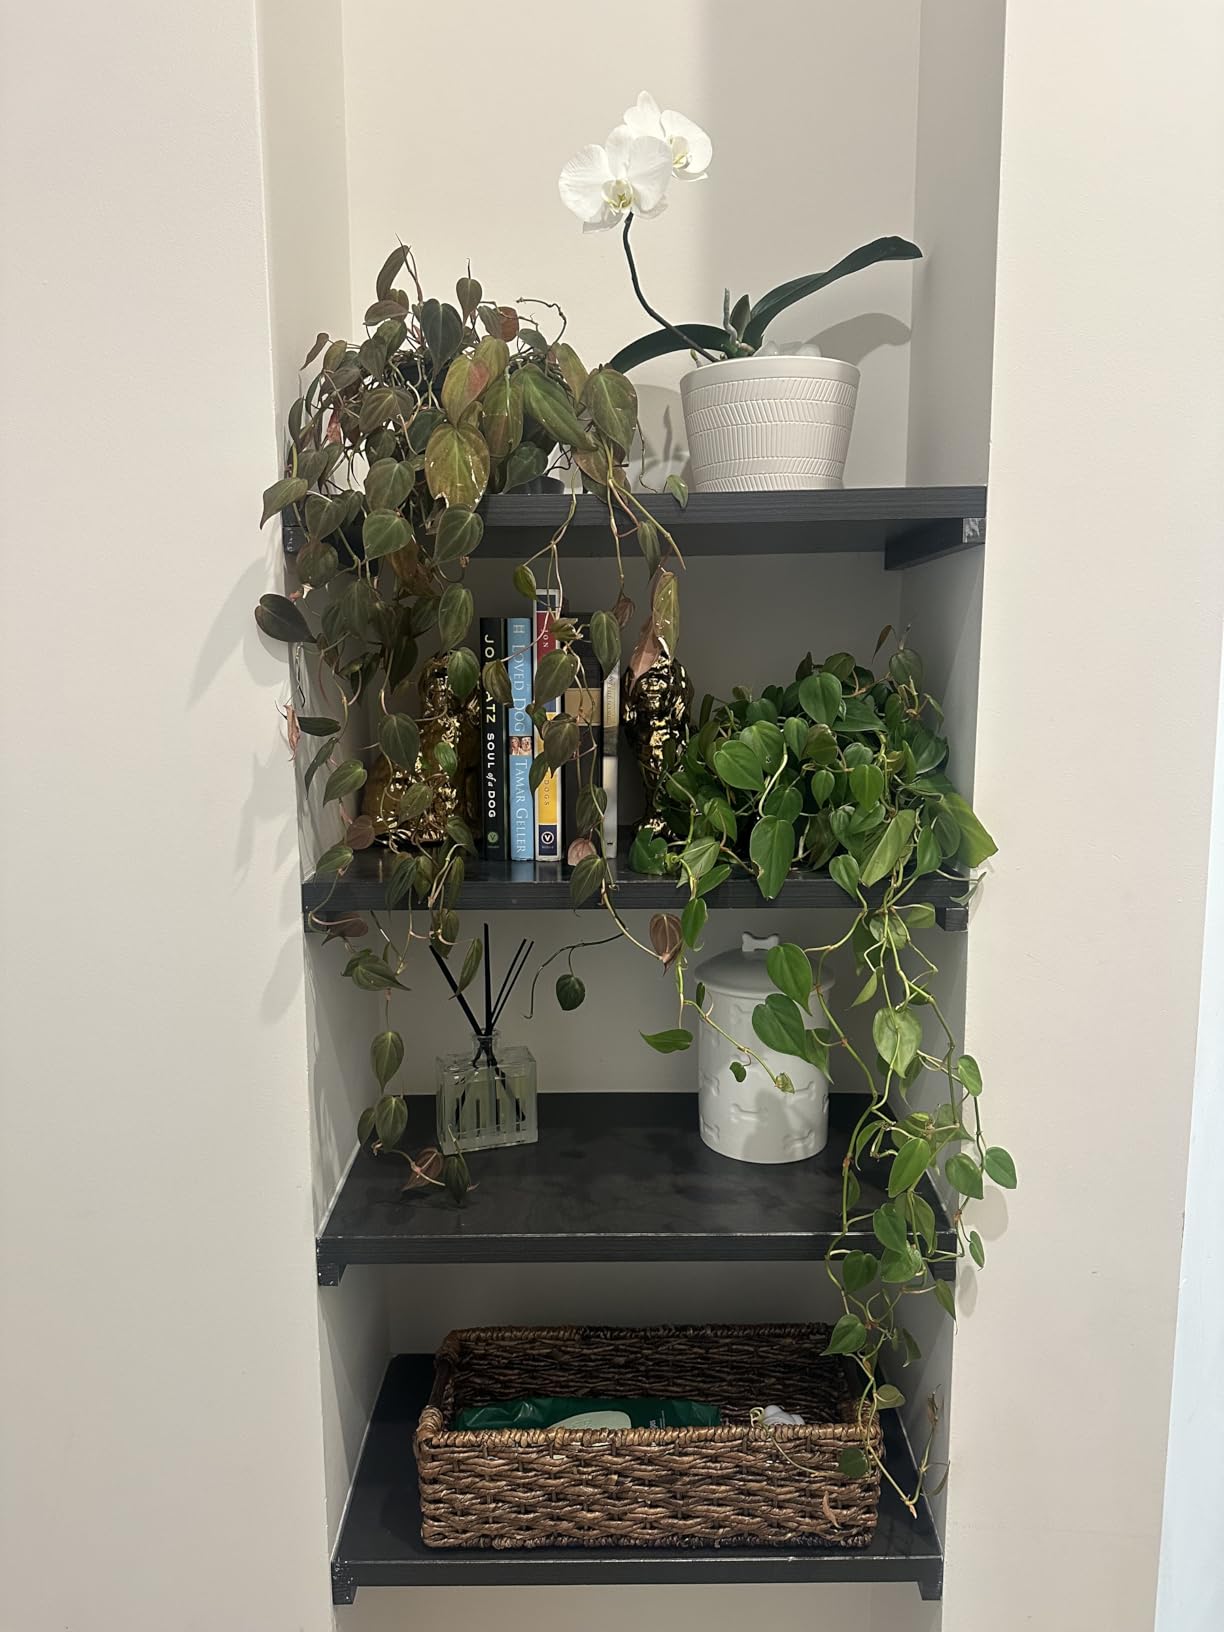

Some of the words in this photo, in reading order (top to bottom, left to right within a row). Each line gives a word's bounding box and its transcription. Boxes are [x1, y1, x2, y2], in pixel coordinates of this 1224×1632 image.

[484, 634, 496, 664] JO
[512, 644, 526, 691] LOVED
[485, 691, 496, 724] ATZ
[513, 698, 527, 732] DOG
[487, 732, 496, 769] SOUL
[486, 772, 497, 782] of
[515, 759, 528, 803] TAMAR
[487, 790, 497, 818] DOG
[515, 807, 528, 853] GELLER
